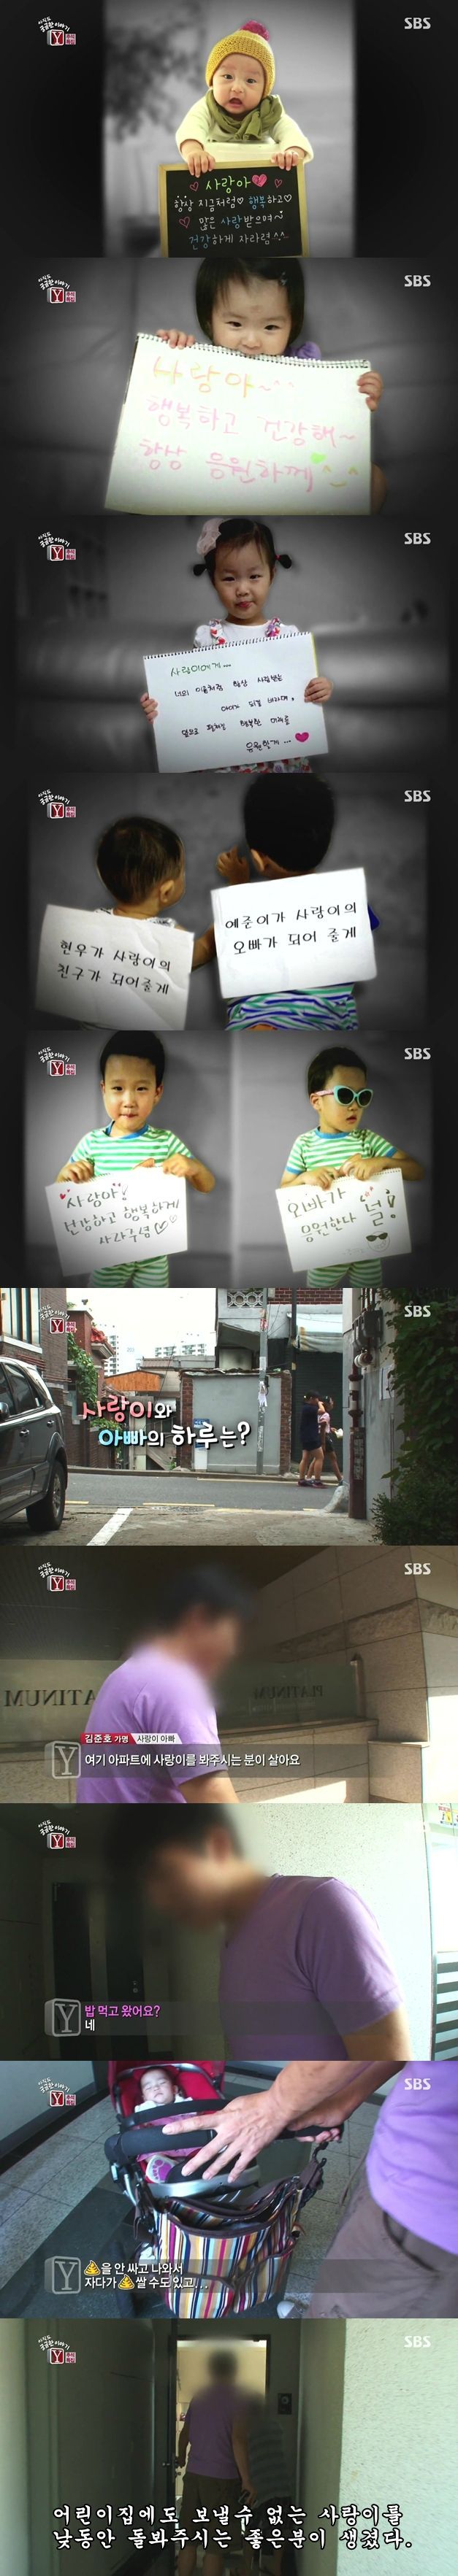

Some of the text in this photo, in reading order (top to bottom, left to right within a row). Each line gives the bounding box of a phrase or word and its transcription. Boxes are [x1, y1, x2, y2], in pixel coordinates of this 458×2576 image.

[206, 176, 251, 193] 사랑아
[175, 195, 283, 212] 항상 지금처럼 행복하고
[199, 217, 215, 231] 많은
[189, 234, 233, 250] 건강하게
[147, 396, 239, 434] 행복하고
[140, 439, 313, 493] 항상 응원하께
[233, 679, 248, 687] 항상
[257, 674, 283, 683] 사랑받는
[182, 728, 199, 738] 앞으로
[240, 718, 262, 728] 행복한
[225, 902, 356, 929] 예준이가 사랑이의
[234, 936, 278, 955] 오빠가
[60, 940, 170, 972] 현우가 사랑이의
[58, 963, 101, 982] 친구가
[123, 1199, 180, 1222] 행복하게
[288, 1187, 346, 1218] 오빠가
[301, 1212, 356, 1243] 응원한다
